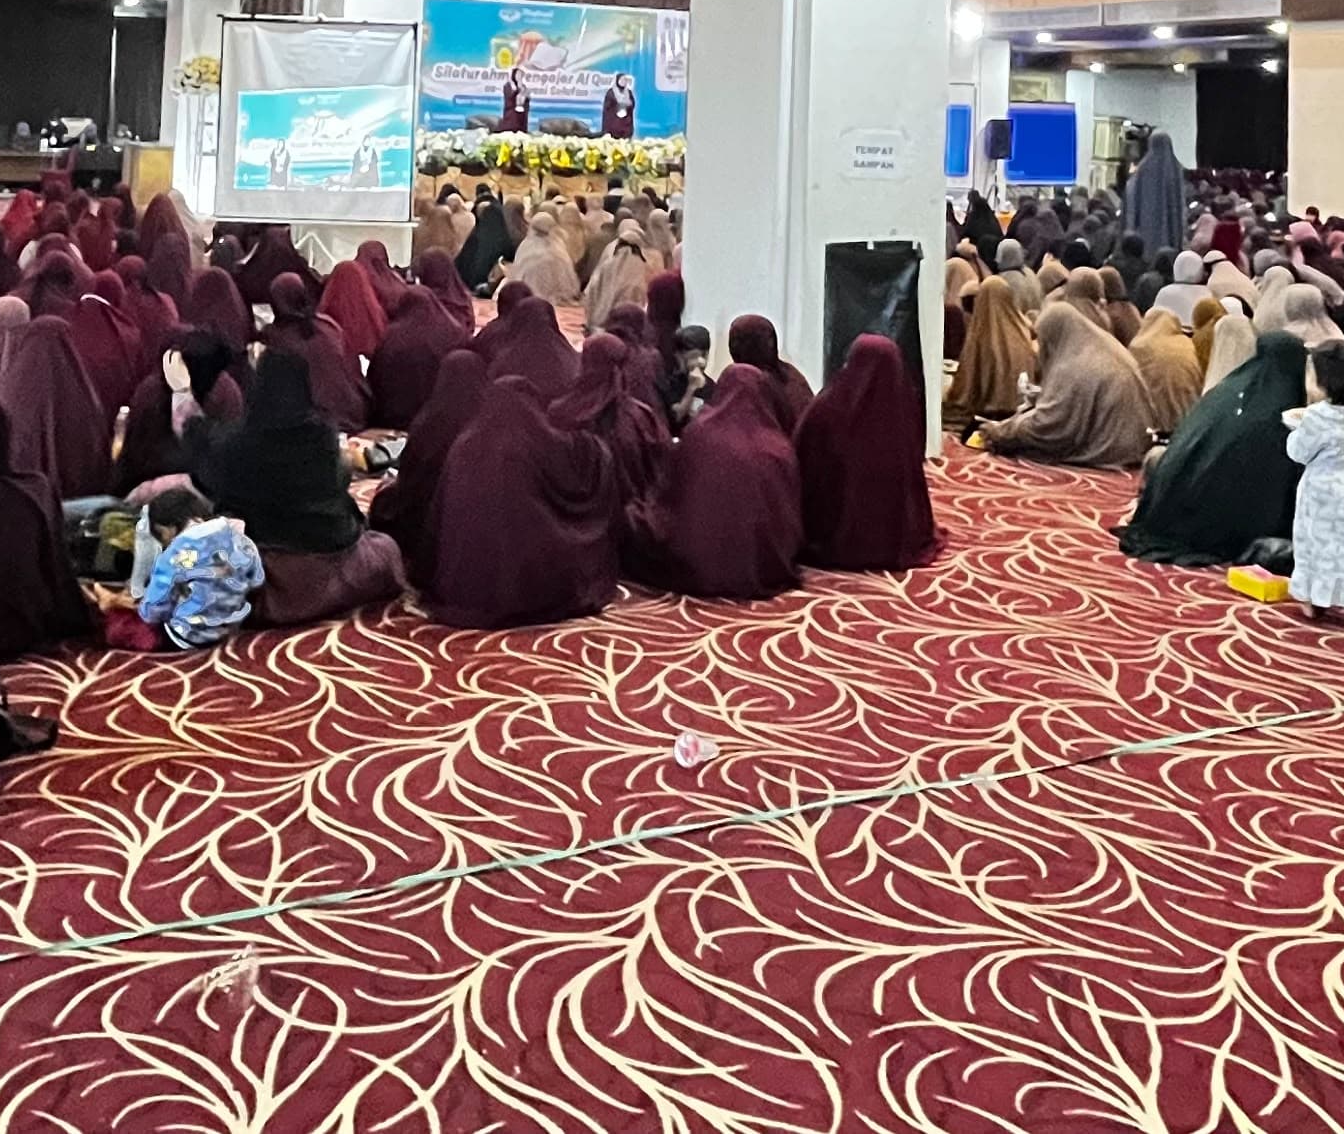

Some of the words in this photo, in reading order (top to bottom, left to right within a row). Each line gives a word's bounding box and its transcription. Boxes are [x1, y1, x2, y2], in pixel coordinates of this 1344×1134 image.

[435, 65, 510, 82] Silaturahm
[576, 72, 590, 85] Al
[855, 145, 894, 155] TEMPAT
